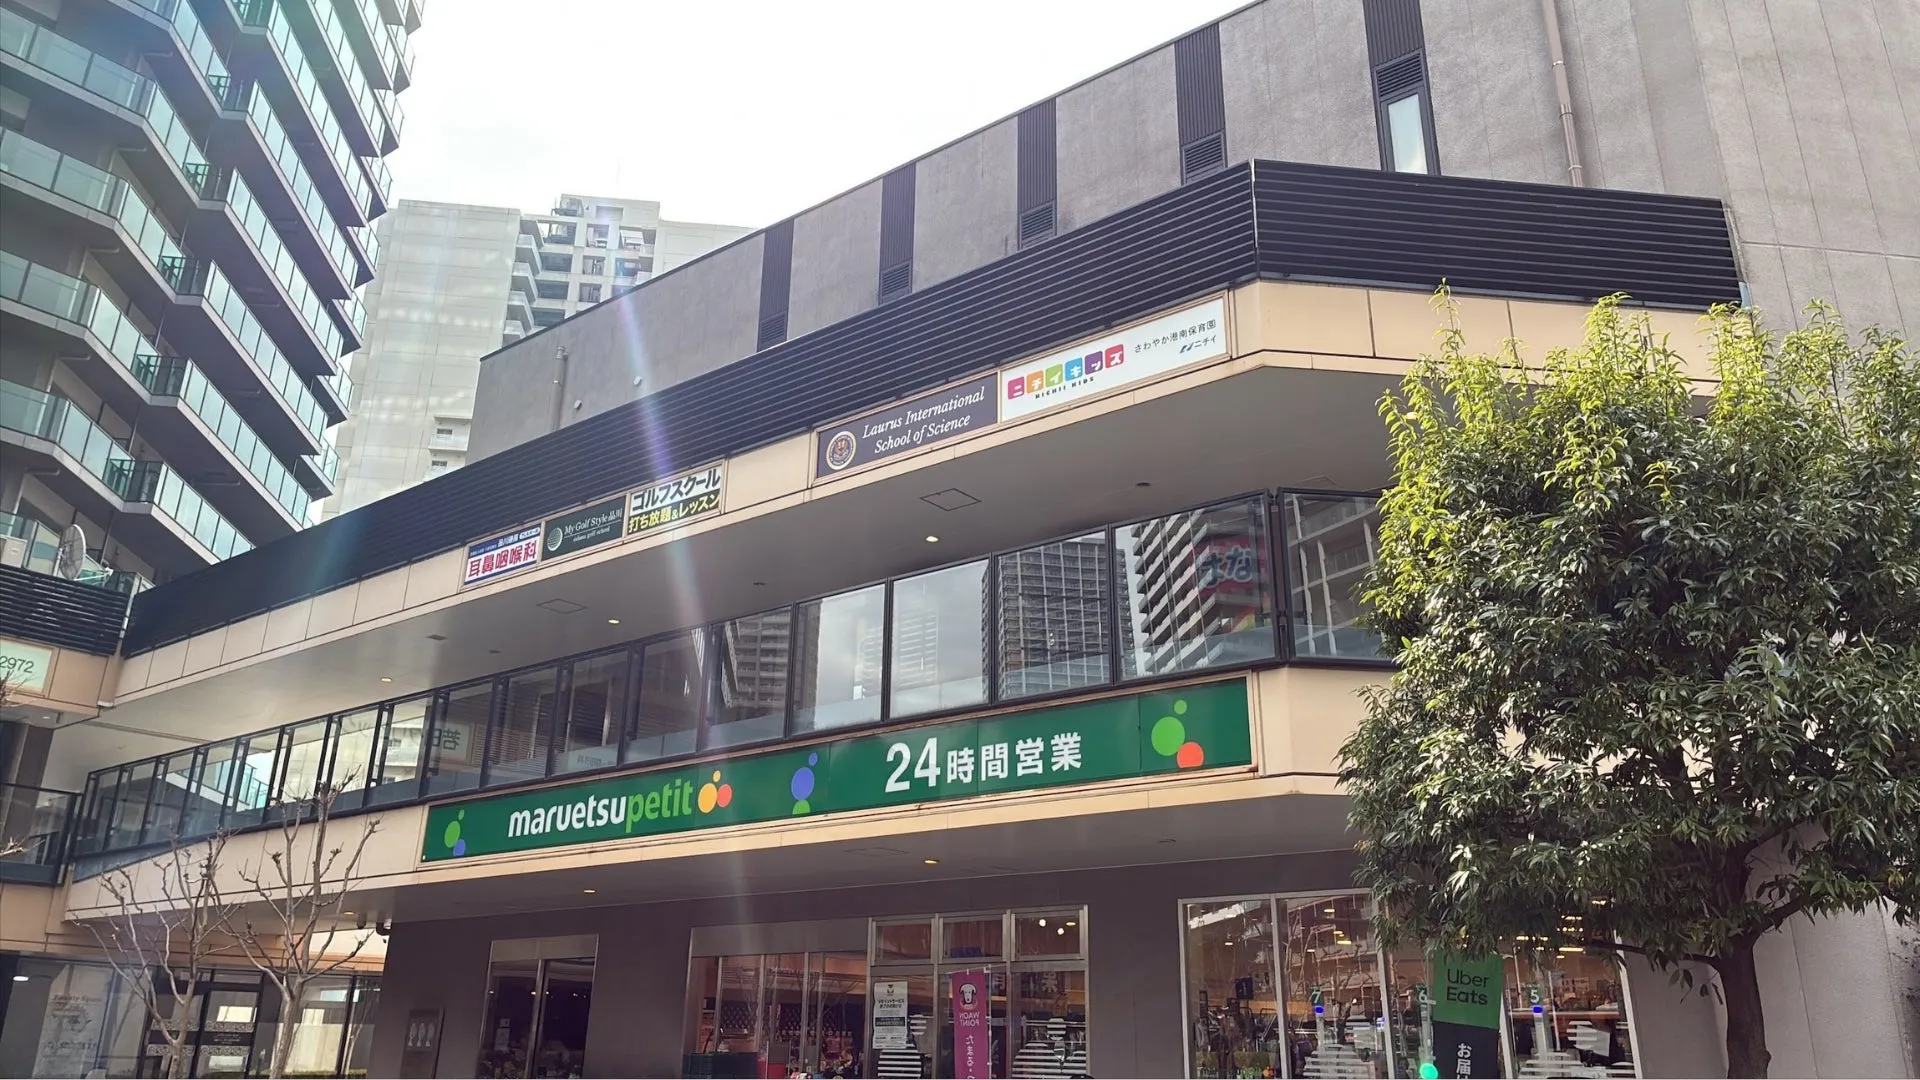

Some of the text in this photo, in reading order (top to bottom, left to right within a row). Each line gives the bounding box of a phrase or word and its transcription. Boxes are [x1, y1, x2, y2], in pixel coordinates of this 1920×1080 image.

[1134, 319, 1217, 354] さわやか港南保育園
[1194, 334, 1217, 350] ニチイ
[1010, 347, 1123, 398] ニチイキッズ
[862, 386, 985, 438] Laurus International
[874, 431, 911, 454] School
[913, 426, 929, 446] of
[928, 413, 971, 438] Science
[632, 468, 721, 511] ゴルフスクール
[575, 517, 591, 531] Golf
[468, 540, 537, 578] 耳鼻咽喉科
[884, 732, 1082, 793] 24時間営業
[1446, 968, 1489, 989] Uber
[1446, 986, 1488, 1006] Eats
[1530, 989, 1540, 1003] 5
